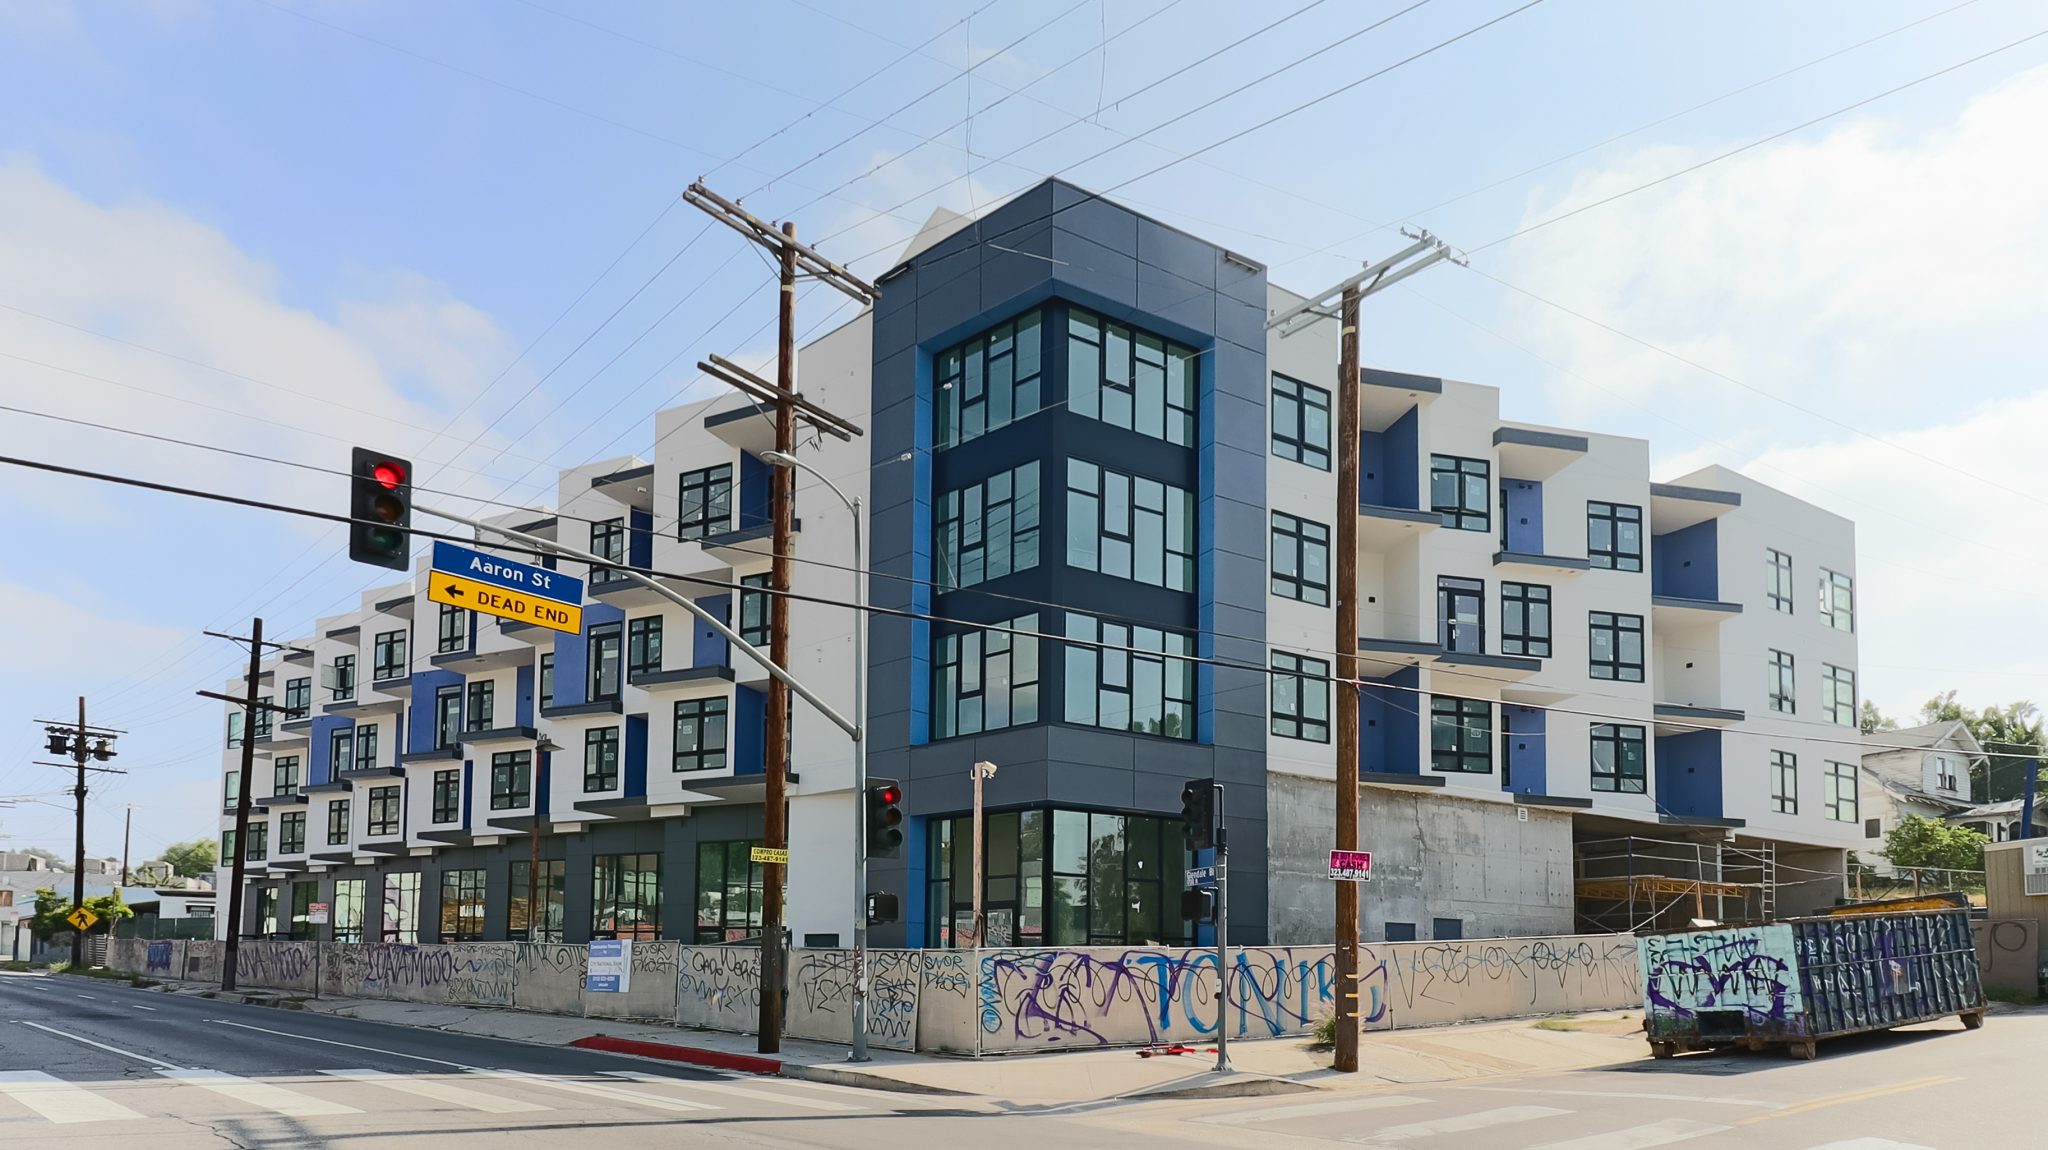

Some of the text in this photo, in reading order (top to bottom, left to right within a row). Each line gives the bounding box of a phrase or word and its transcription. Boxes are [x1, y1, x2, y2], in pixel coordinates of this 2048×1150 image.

[470, 556, 552, 590] Aaron St
[477, 591, 569, 624] DEAD END
